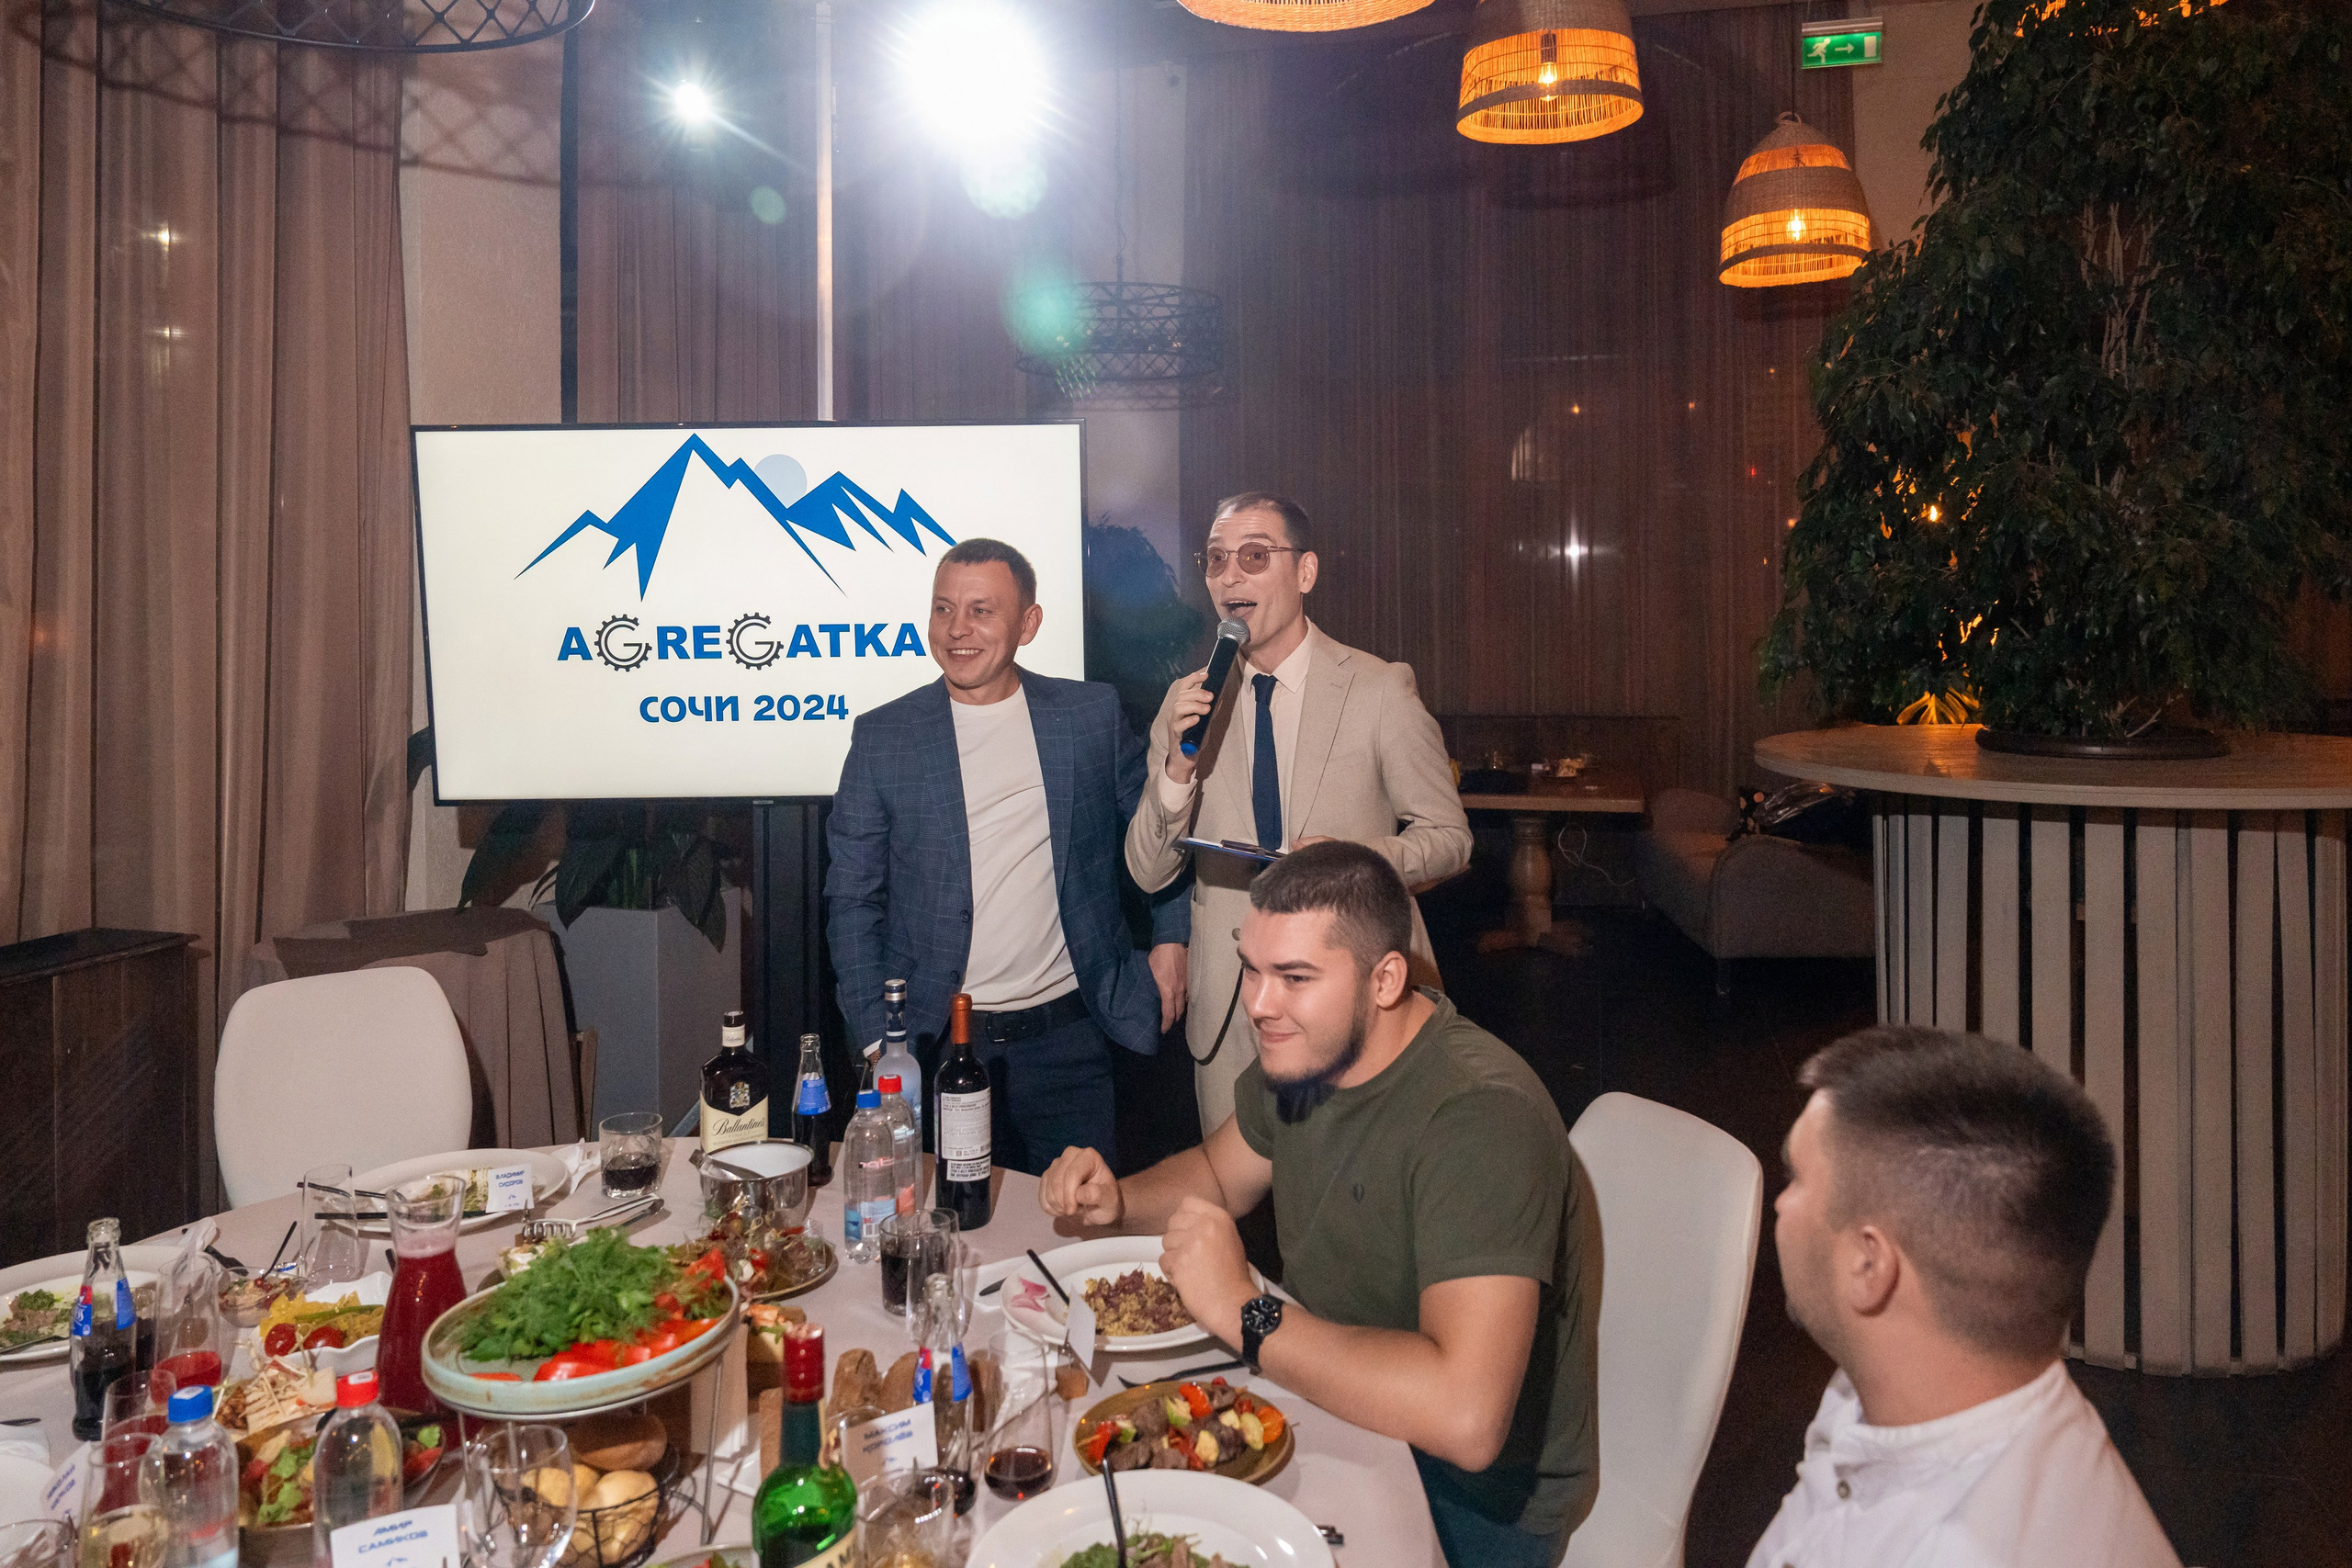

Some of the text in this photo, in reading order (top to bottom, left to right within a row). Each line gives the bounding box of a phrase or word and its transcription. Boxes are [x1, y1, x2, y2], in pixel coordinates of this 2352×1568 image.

[557, 612, 927, 672] AGREGATKA
[639, 694, 849, 723] СОЧИ 2024
[712, 1118, 765, 1136] Ballantine's
